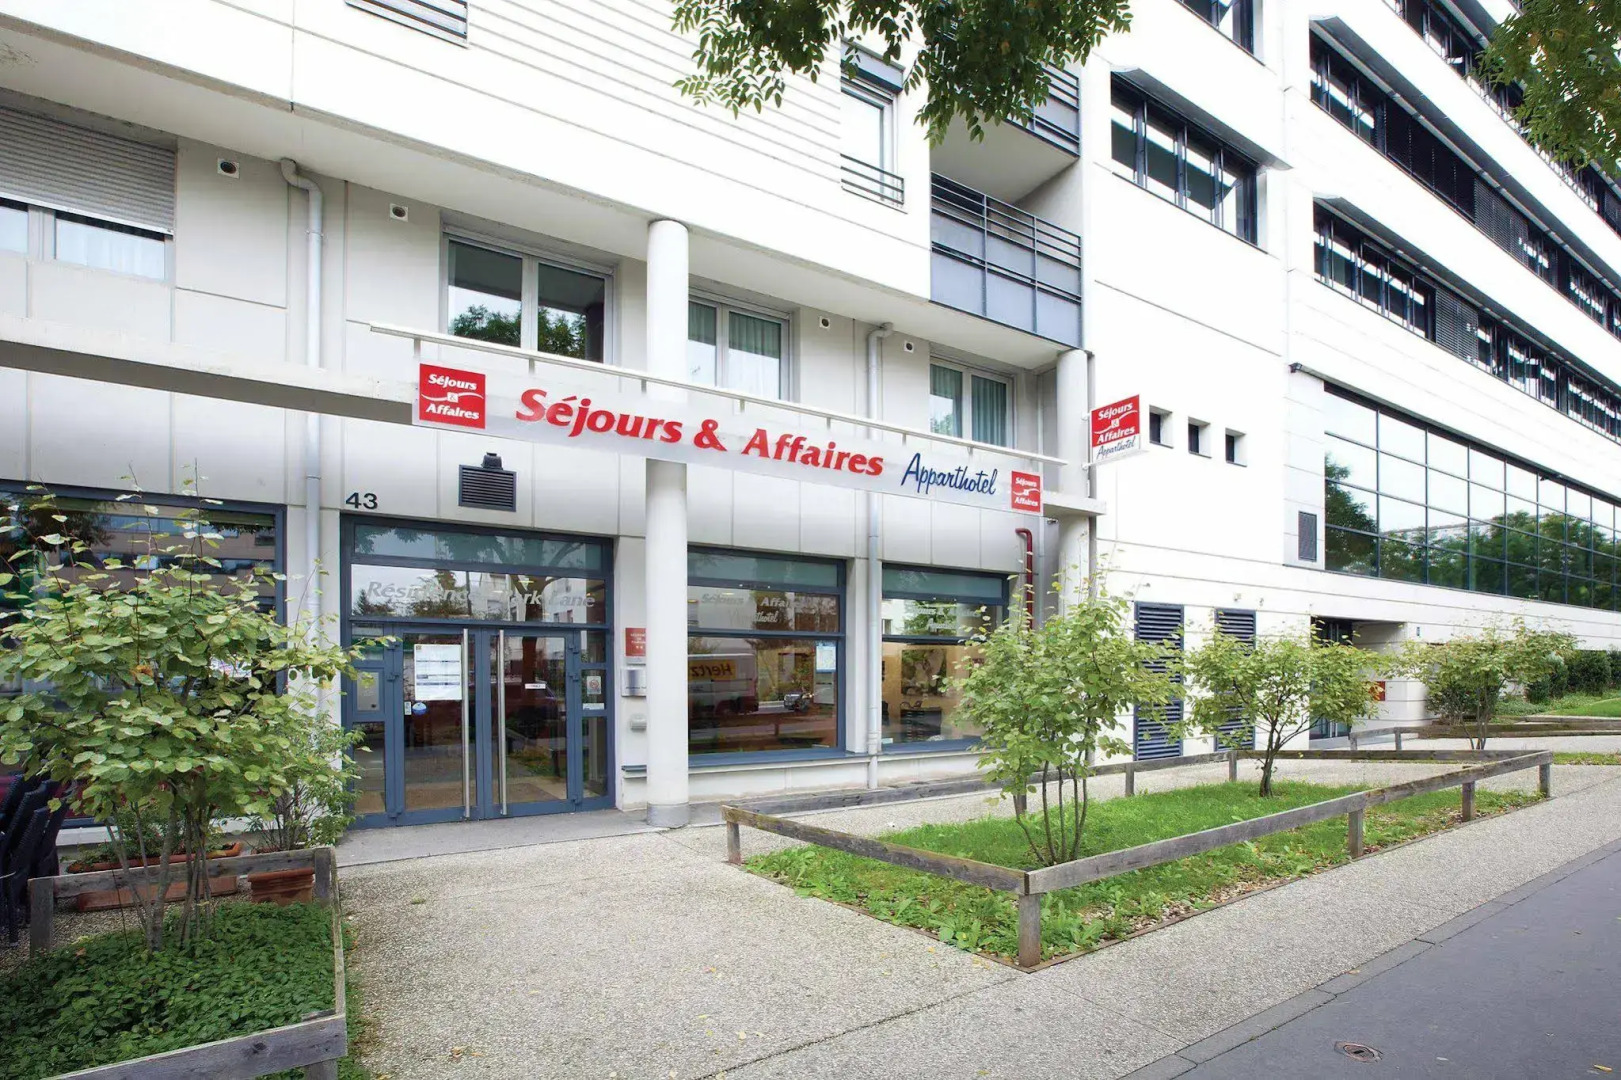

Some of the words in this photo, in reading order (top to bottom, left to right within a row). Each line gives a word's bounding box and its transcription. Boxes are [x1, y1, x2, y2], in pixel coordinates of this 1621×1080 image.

[428, 373, 477, 391] Séjours
[425, 403, 480, 420] Affaires
[1098, 403, 1133, 420] Séjours
[515, 388, 683, 444] Séjours
[693, 418, 728, 452] &
[740, 428, 884, 476] Affaires
[1097, 426, 1135, 445] Affaires
[900, 452, 998, 495] Apparthotel
[1015, 476, 1037, 487] Séjours
[345, 492, 378, 510] 43
[1014, 496, 1039, 507] Affaires
[366, 581, 482, 604] Résidenc
